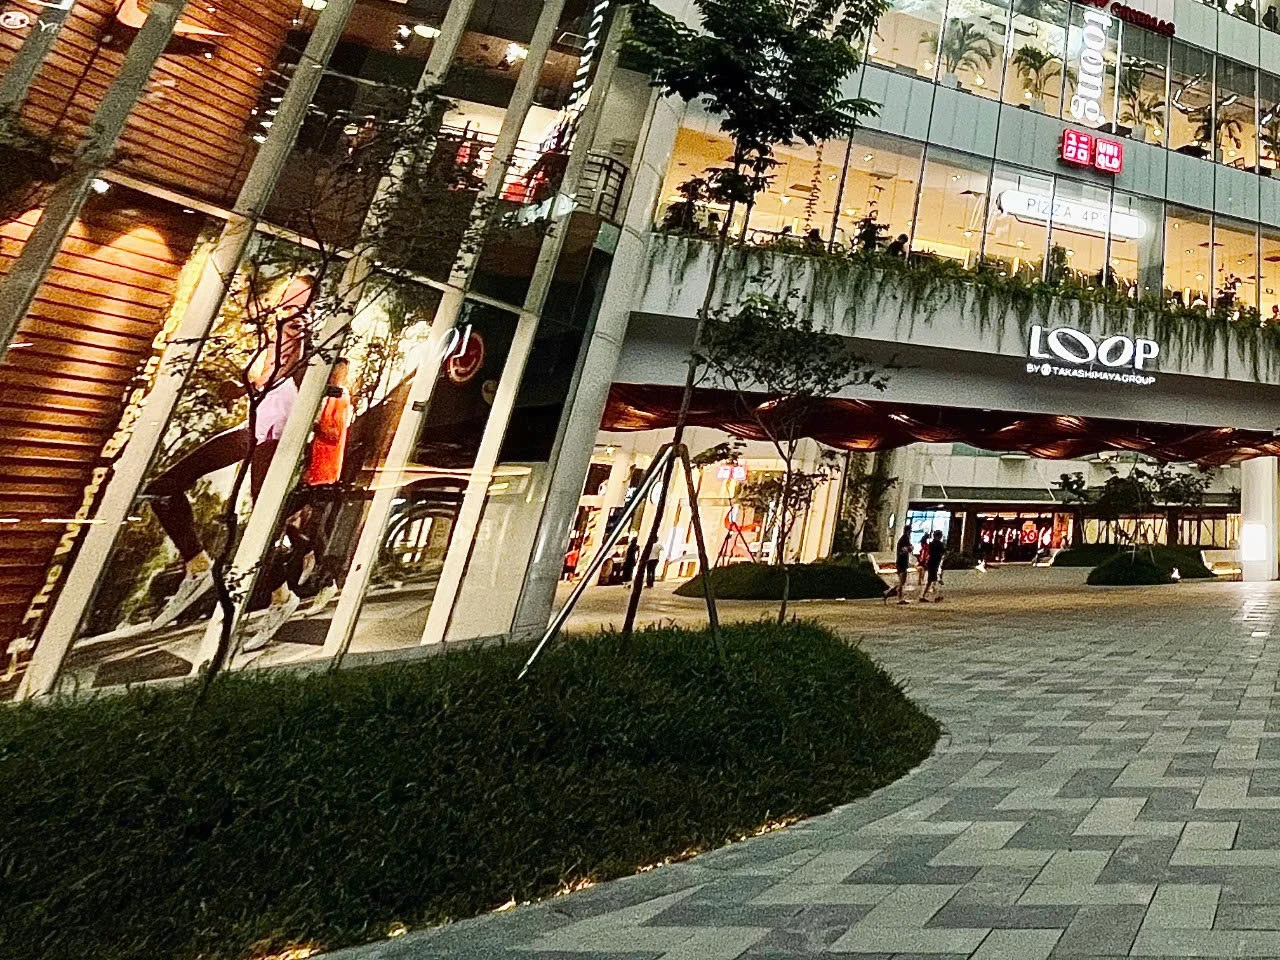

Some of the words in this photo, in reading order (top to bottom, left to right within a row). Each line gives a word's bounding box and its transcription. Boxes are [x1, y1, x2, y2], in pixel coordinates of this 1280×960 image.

[1110, 1, 1176, 37] CINEMAS
[1070, 9, 1112, 126] toong
[1027, 197, 1072, 218] PIZZA
[1029, 325, 1160, 370] LOOP
[1026, 363, 1041, 374] BY
